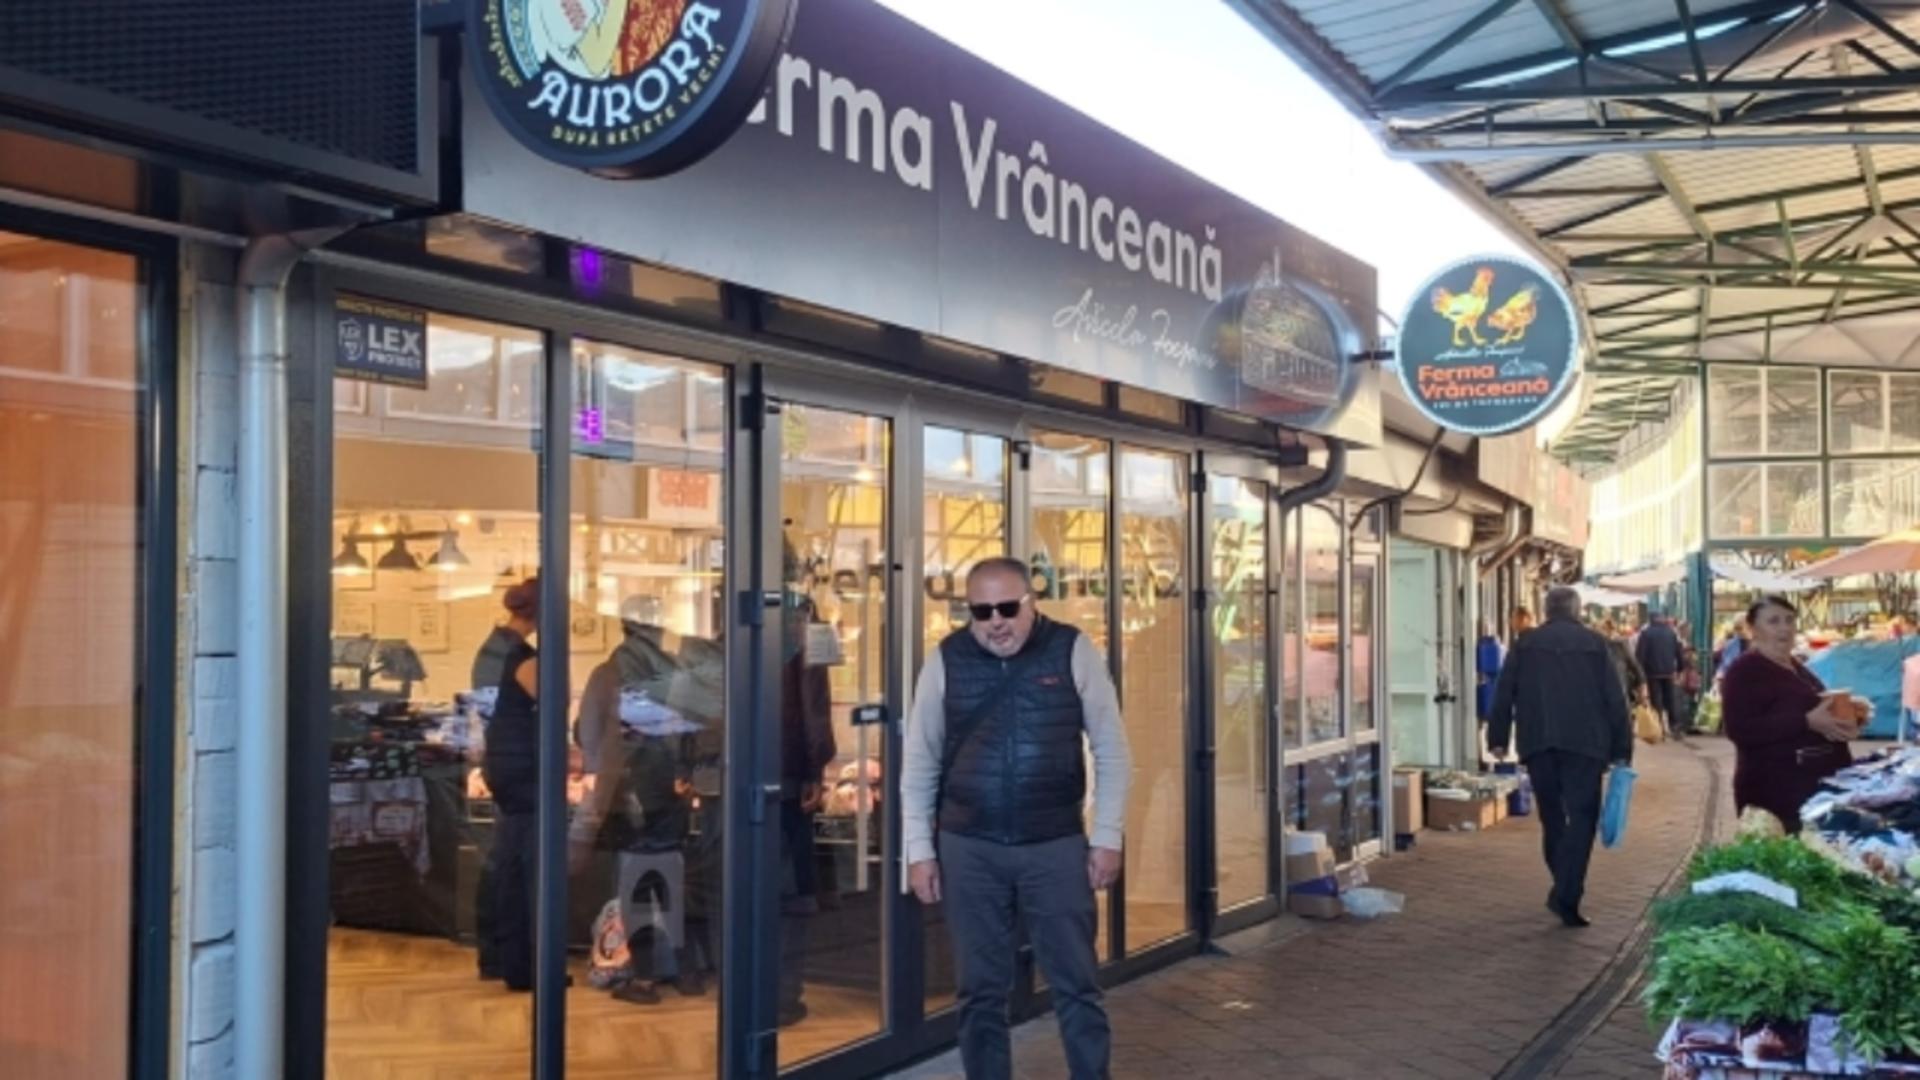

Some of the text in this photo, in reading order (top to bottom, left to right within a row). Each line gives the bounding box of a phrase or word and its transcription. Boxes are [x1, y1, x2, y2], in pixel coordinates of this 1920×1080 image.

[527, 1, 721, 128] AURORA
[746, 51, 1222, 302] rma Vrânceană
[367, 323, 421, 357] LEX
[1418, 364, 1495, 382] Ferma
[1418, 376, 1549, 399] Vrânceană
